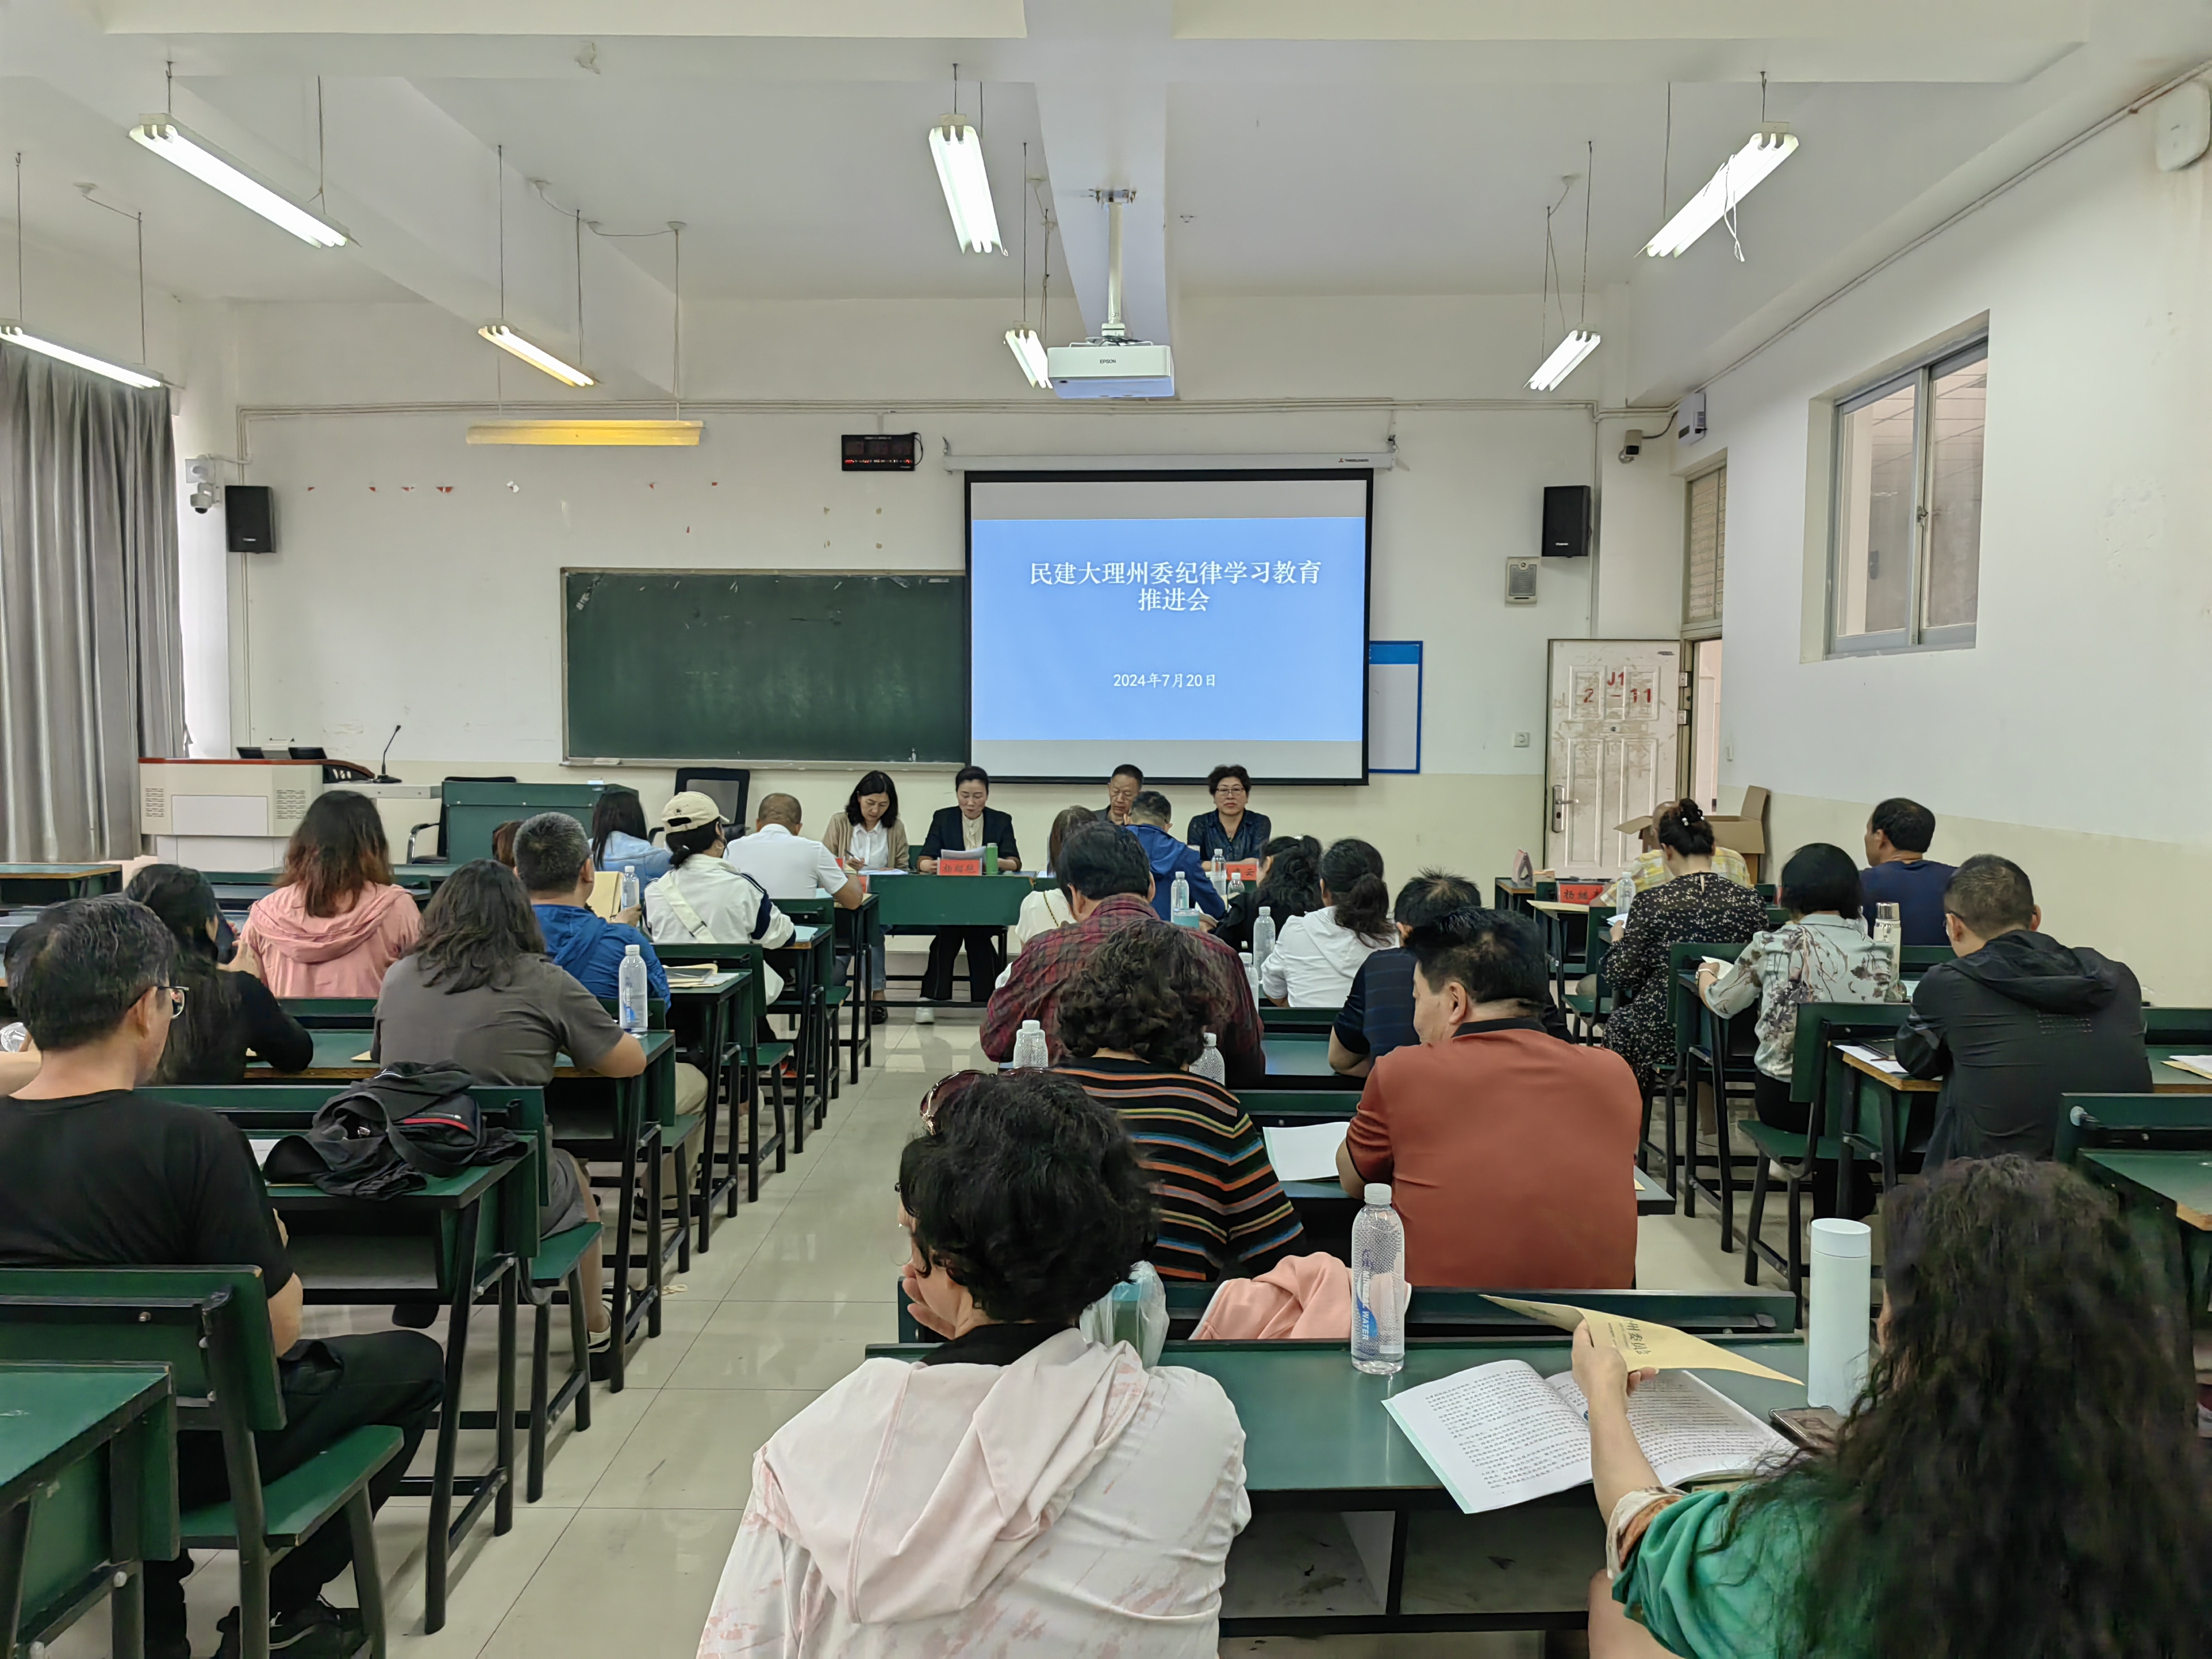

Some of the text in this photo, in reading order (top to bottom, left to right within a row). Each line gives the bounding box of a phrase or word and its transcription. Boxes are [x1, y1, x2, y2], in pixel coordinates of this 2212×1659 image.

[1030, 560, 1321, 585] 民建大理州委纪律学习教育
[1138, 588, 1209, 612] 推进会
[1113, 673, 1216, 689] 2024年7月20日
[1607, 672, 1624, 686] J1
[1362, 1311, 1370, 1340] WATER
